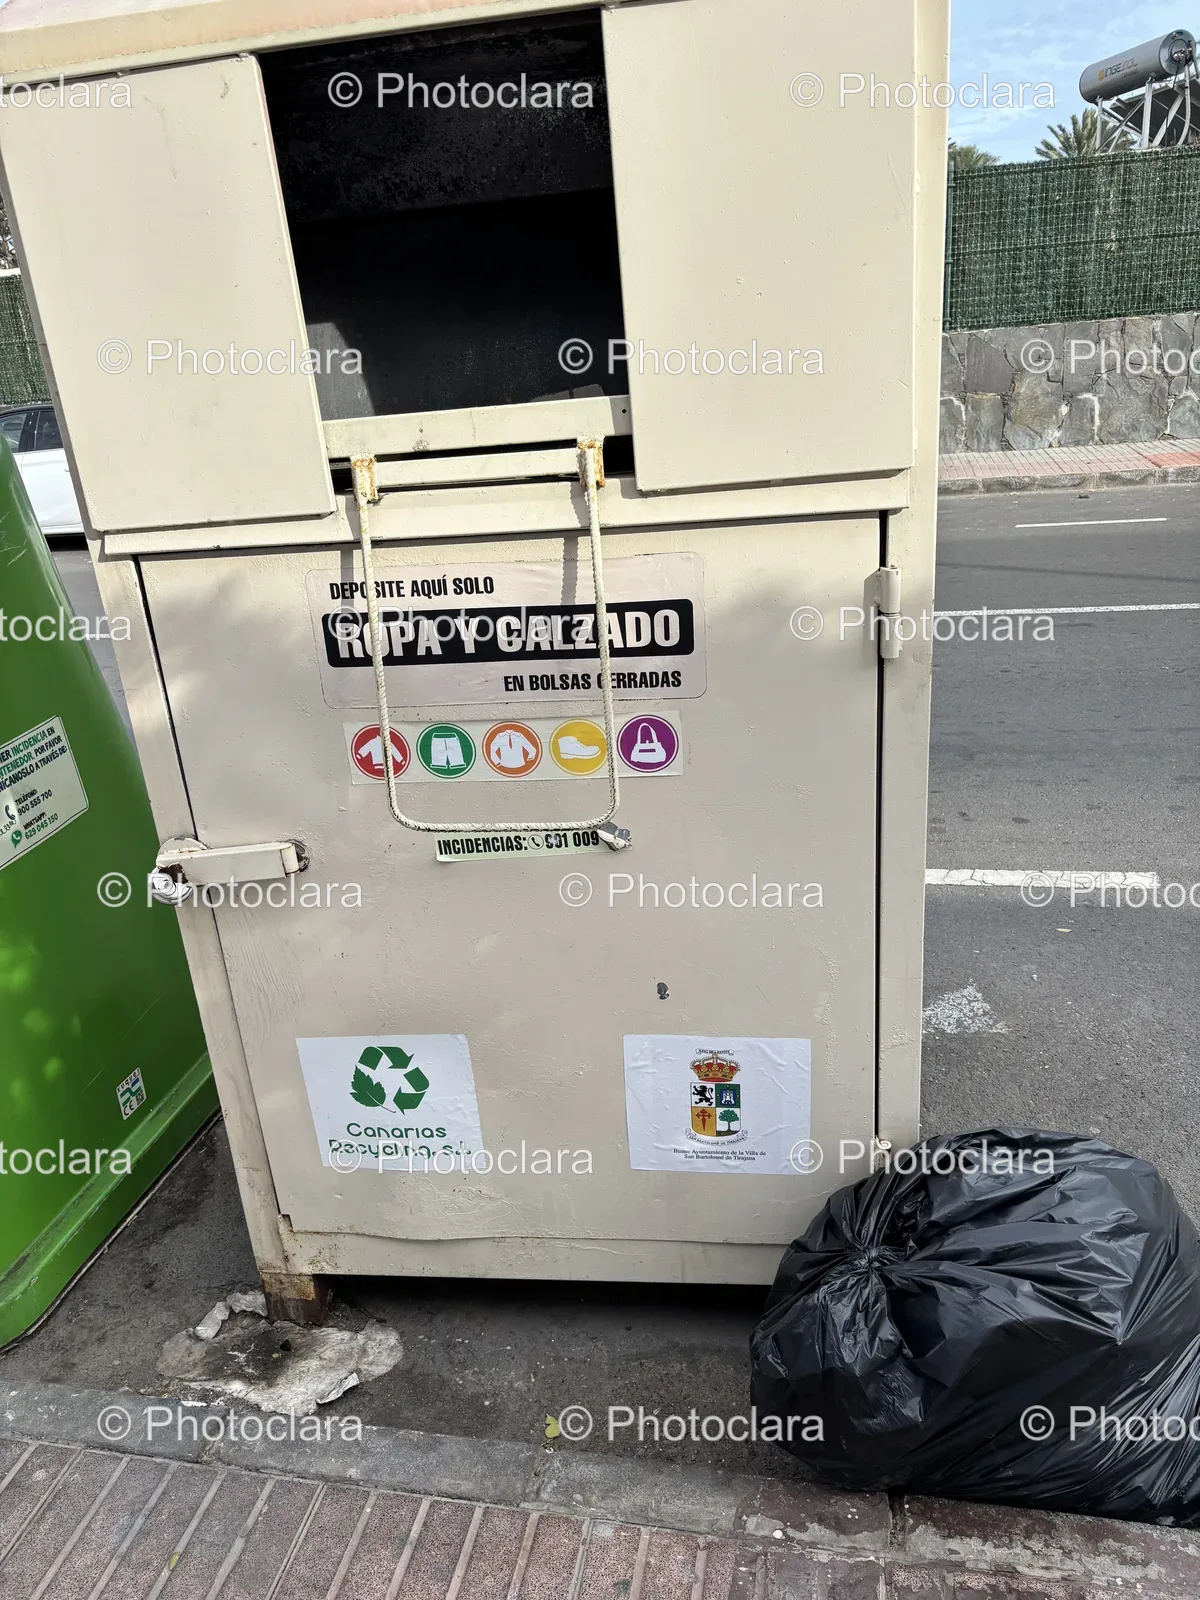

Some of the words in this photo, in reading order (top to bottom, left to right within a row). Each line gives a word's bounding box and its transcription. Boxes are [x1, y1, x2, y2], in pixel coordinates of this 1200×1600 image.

[329, 581, 405, 600] DEPOSITE
[411, 575, 448, 599] AQUÍ
[453, 577, 495, 595] SOLO
[335, 618, 442, 658] ROPA
[454, 618, 479, 654] Y
[496, 609, 681, 653] CALZADO
[503, 675, 524, 692] EN
[529, 673, 591, 691] BOLSAS
[11, 730, 48, 757] INCIDENCIA
[46, 726, 56, 737] EN
[34, 745, 45, 757] POR
[44, 735, 63, 751] FAVOR
[38, 749, 59, 768] TRAVÉS
[17, 804, 30, 816] 900
[29, 796, 41, 809] 555
[40, 789, 53, 802] 700
[25, 827, 37, 840] 629
[36, 819, 48, 832] 045
[48, 813, 59, 825] 150
[437, 834, 527, 856] INCIDENCIAS:
[573, 830, 599, 848] 009
[346, 1122, 447, 1138] Canarias
